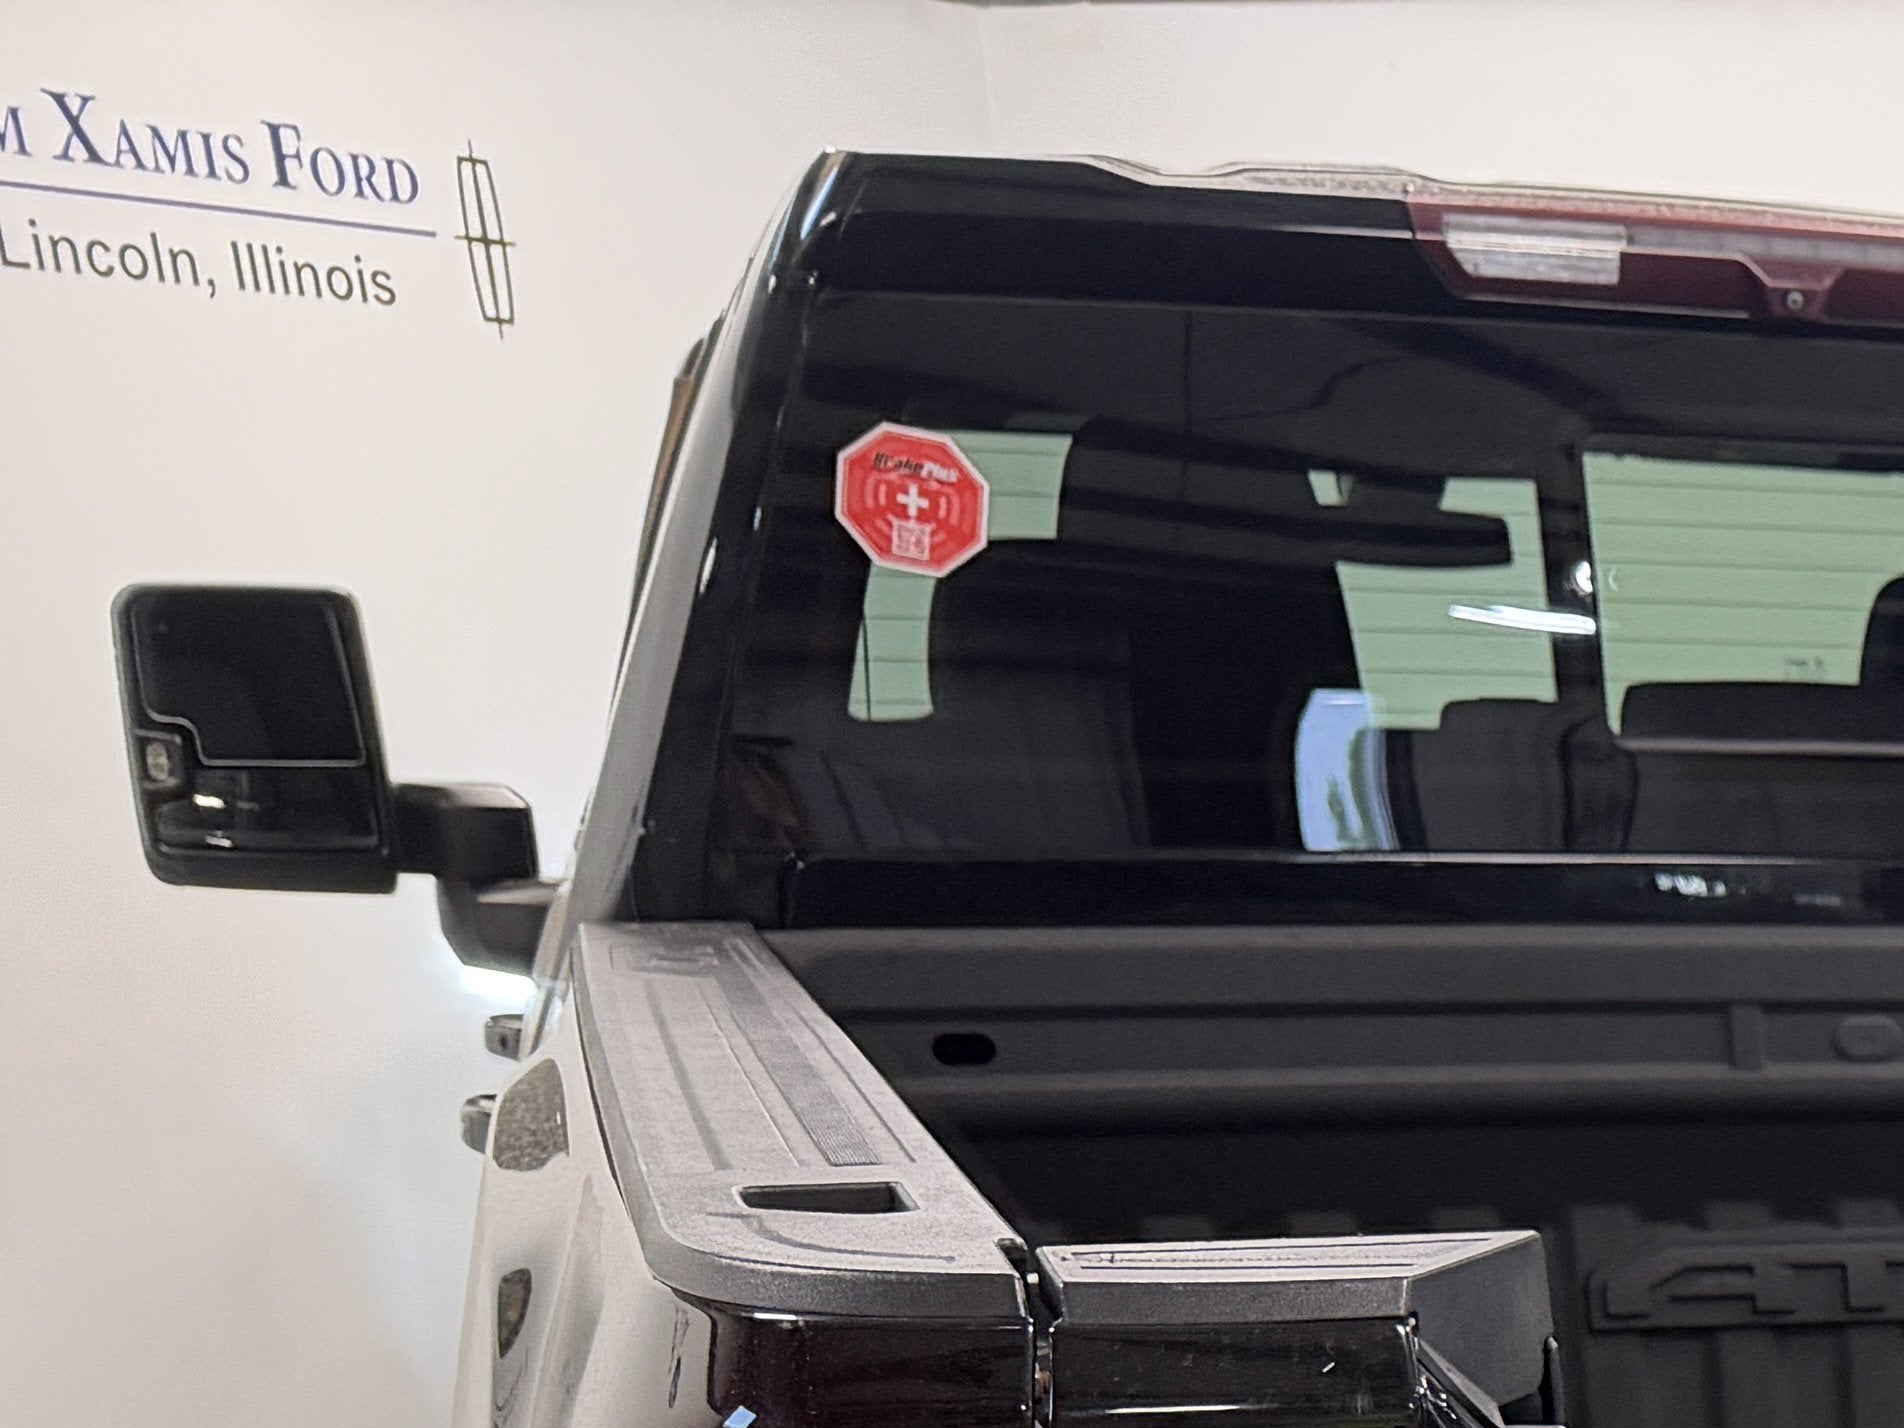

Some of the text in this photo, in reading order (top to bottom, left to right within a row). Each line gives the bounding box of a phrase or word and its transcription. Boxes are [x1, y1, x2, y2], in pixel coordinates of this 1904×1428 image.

[40, 87, 250, 185] XAMIS
[260, 119, 420, 205] FORD
[0, 217, 398, 306] Lincoln, Illinois
